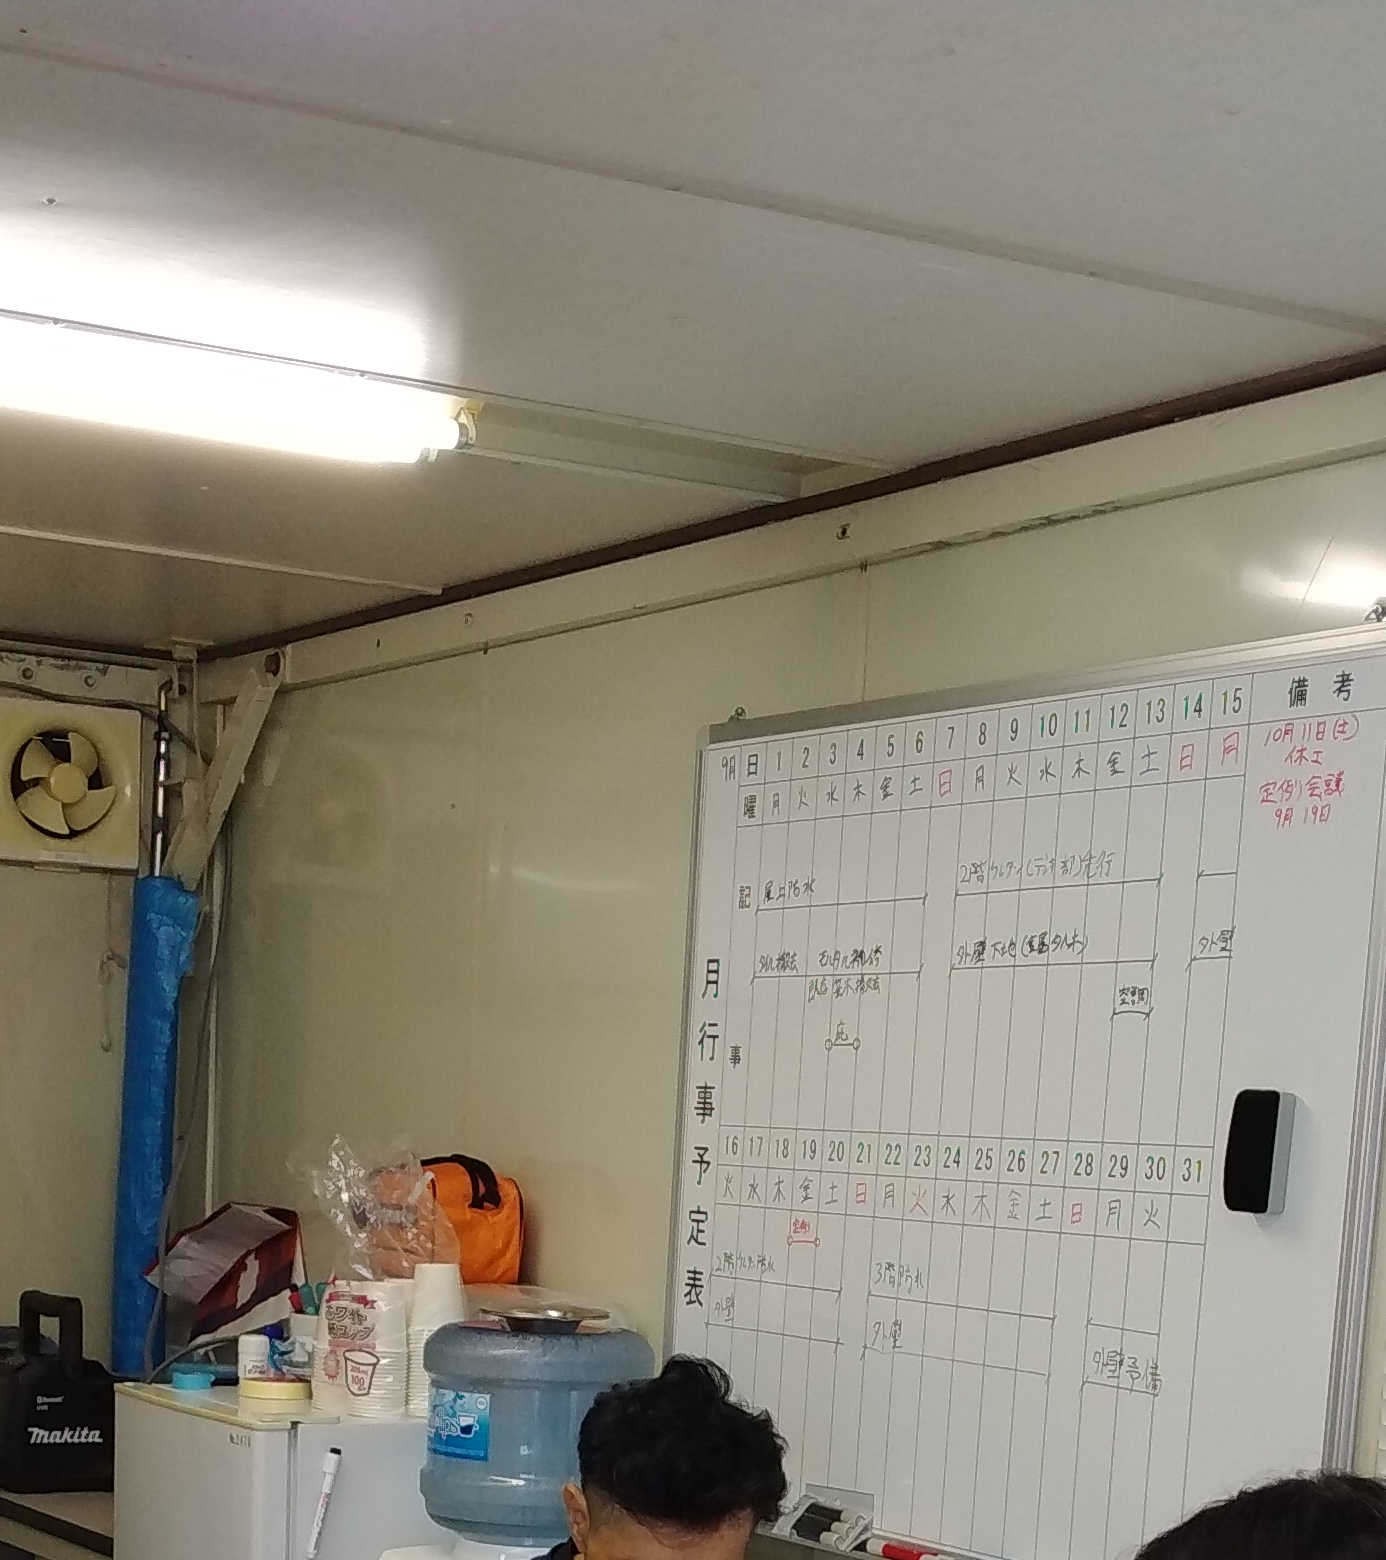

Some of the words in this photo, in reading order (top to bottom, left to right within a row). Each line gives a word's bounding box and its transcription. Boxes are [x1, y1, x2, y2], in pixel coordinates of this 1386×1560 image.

[747, 753, 759, 777] 日
[776, 751, 782, 771] 1
[802, 747, 810, 768] 2
[829, 743, 837, 764] 3
[856, 738, 864, 760] 4
[887, 734, 895, 757] 5
[915, 731, 923, 753] 6
[947, 726, 955, 749] 7
[978, 721, 987, 745] 8
[1010, 717, 1019, 741] 9
[1039, 712, 1058, 738] 10
[1074, 708, 1091, 733] 11
[1110, 703, 1129, 729] 12
[1146, 698, 1165, 724] 13
[1183, 692, 1203, 720] 14
[1222, 687, 1242, 715] 15
[772, 792, 780, 816] 月
[798, 786, 809, 809] 火
[826, 781, 838, 807] 水
[852, 778, 866, 801] 木
[880, 776, 893, 800] 金
[909, 775, 923, 796] 土
[939, 768, 952, 797] 日
[974, 765, 985, 791] 月
[1007, 762, 1022, 786] 火
[1040, 756, 1056, 782] 水
[1071, 752, 1090, 779] 木
[1106, 750, 1125, 777] 金
[1139, 744, 1160, 776] 土
[1180, 743, 1194, 771] 日
[1221, 731, 1239, 766] 月
[724, 1135, 739, 1156] 16
[749, 1136, 763, 1157] 17
[775, 1137, 790, 1159] 18
[802, 1138, 817, 1160] 19
[828, 1140, 844, 1162] 20
[856, 1141, 872, 1164] 21
[884, 1143, 901, 1166] 22
[913, 1144, 931, 1167] 23
[943, 1146, 961, 1169] 24
[974, 1147, 993, 1171] 25
[1007, 1149, 1026, 1172] 26
[1040, 1151, 1060, 1175] 27
[1073, 1152, 1094, 1177] 28
[1108, 1154, 1129, 1178] 29
[1145, 1156, 1166, 1181] 30
[1182, 1157, 1202, 1184] 31
[723, 1172, 733, 1199] 火
[747, 1173, 762, 1202] 水
[773, 1174, 786, 1202] 木
[799, 1176, 814, 1204] 金
[825, 1181, 838, 1205] 土
[855, 1183, 867, 1204] 日
[883, 1183, 895, 1209] 月
[910, 1184, 929, 1216] 火
[941, 1188, 957, 1217] 水
[971, 1182, 991, 1223] 木
[1007, 1188, 1021, 1220] 金
[1035, 1198, 1053, 1221] 土
[1071, 1202, 1083, 1225] 日
[1106, 1199, 1121, 1231] 月
[1143, 1199, 1160, 1229] 火
[27, 1426, 103, 1445] makita
